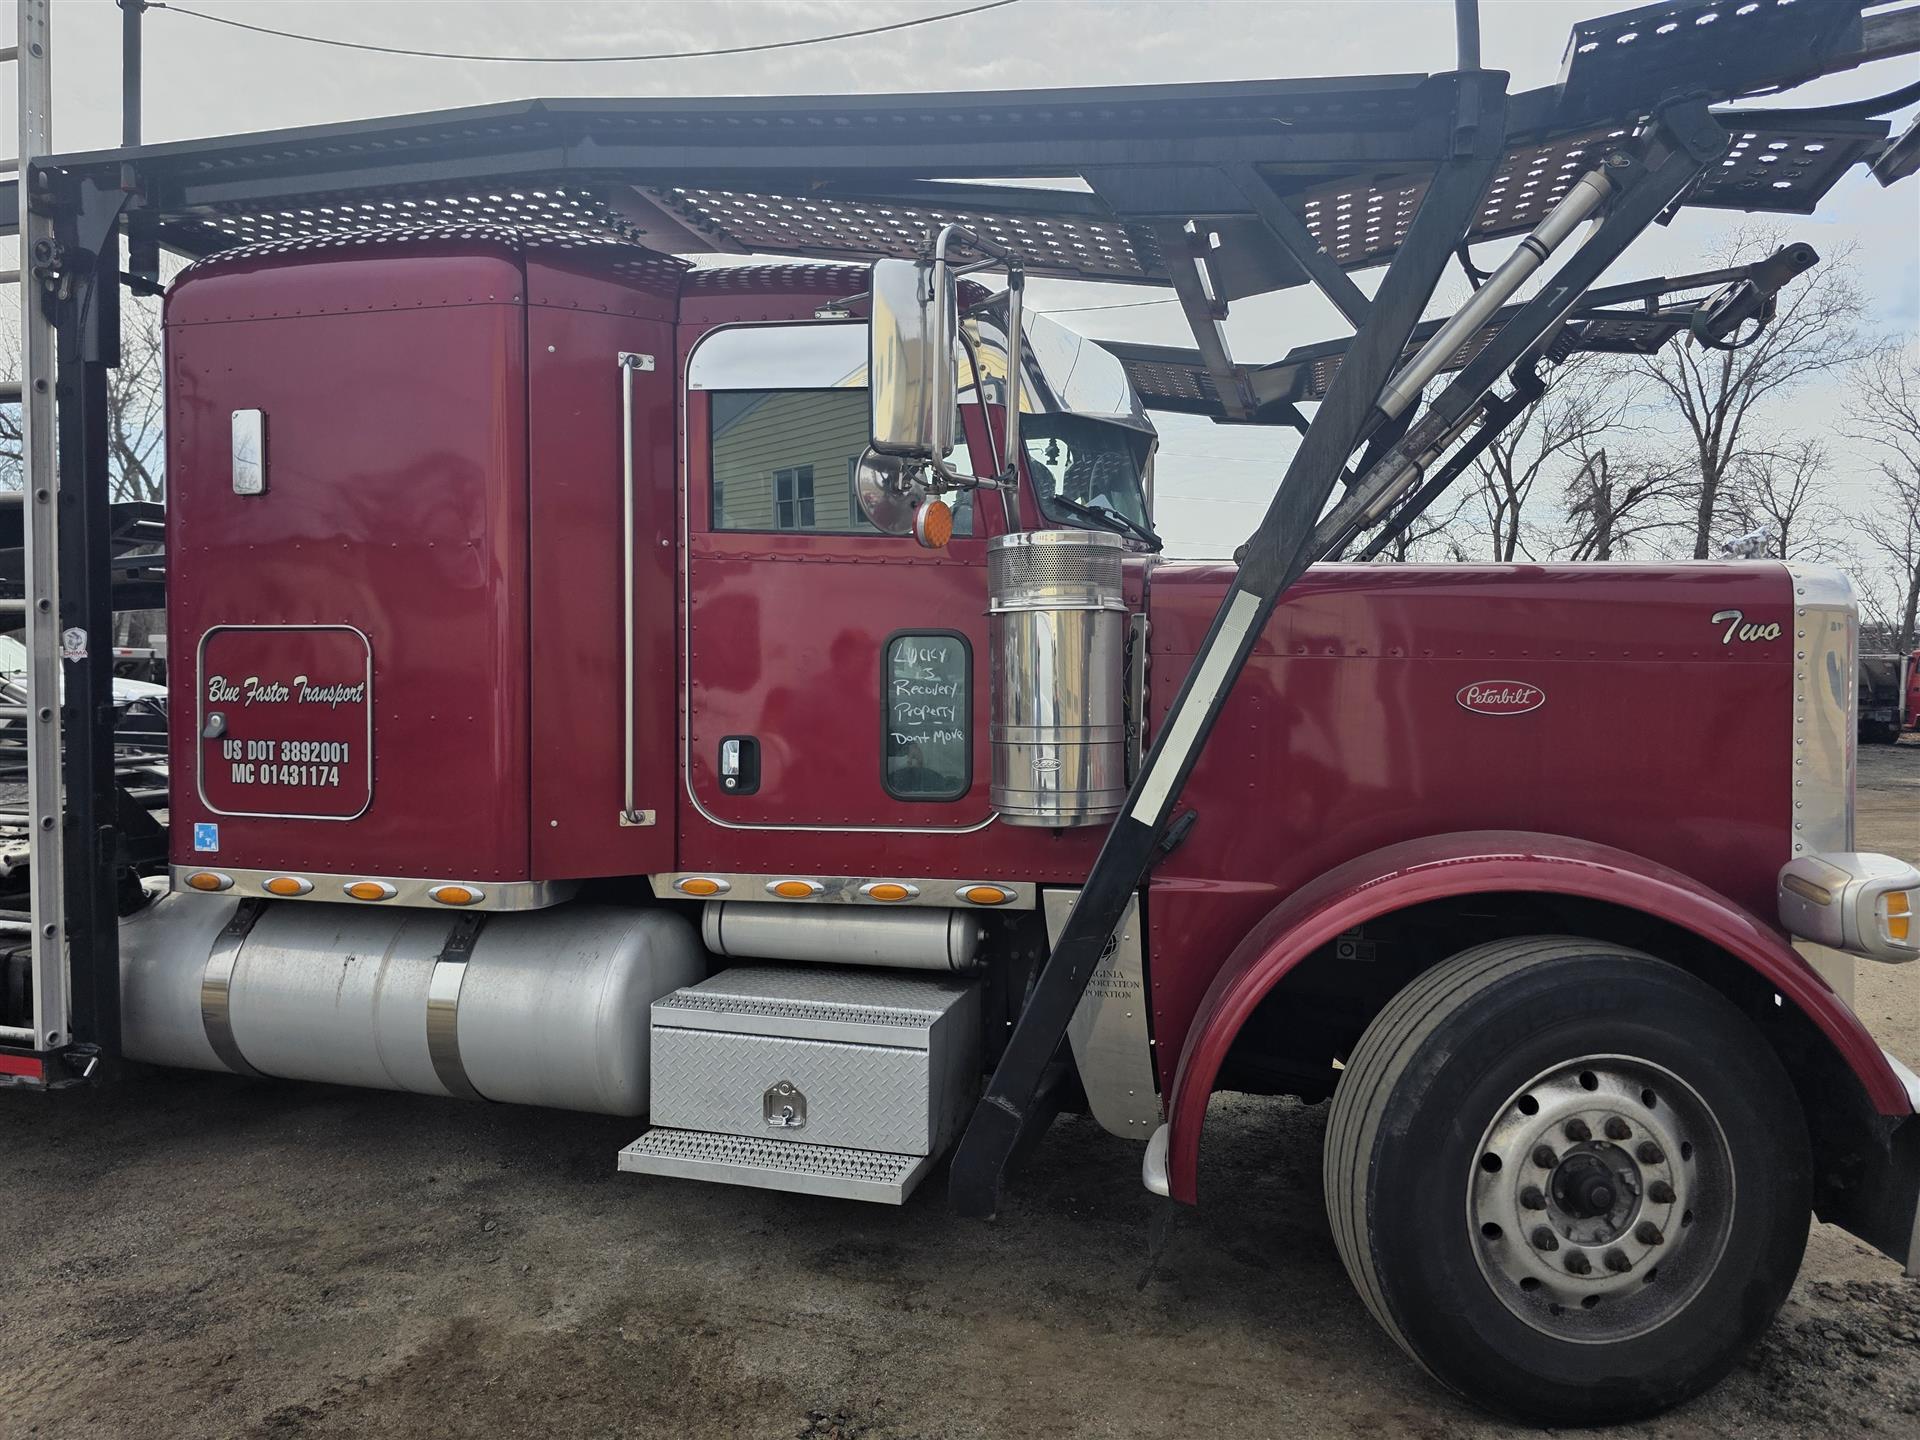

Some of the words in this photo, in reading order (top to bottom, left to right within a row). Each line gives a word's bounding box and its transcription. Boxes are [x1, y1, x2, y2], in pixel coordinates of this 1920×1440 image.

[1711, 609, 1782, 645] Two
[208, 675, 240, 702] Blue
[243, 676, 289, 707] Faster
[293, 675, 365, 709] Transport
[1466, 686, 1537, 705] Peterbilt
[223, 739, 243, 760] US
[247, 740, 276, 761] DOT
[281, 741, 349, 763] 3892001
[231, 763, 255, 784] MC
[260, 764, 340, 787] 01431174
[1093, 970, 1124, 979] GINIA
